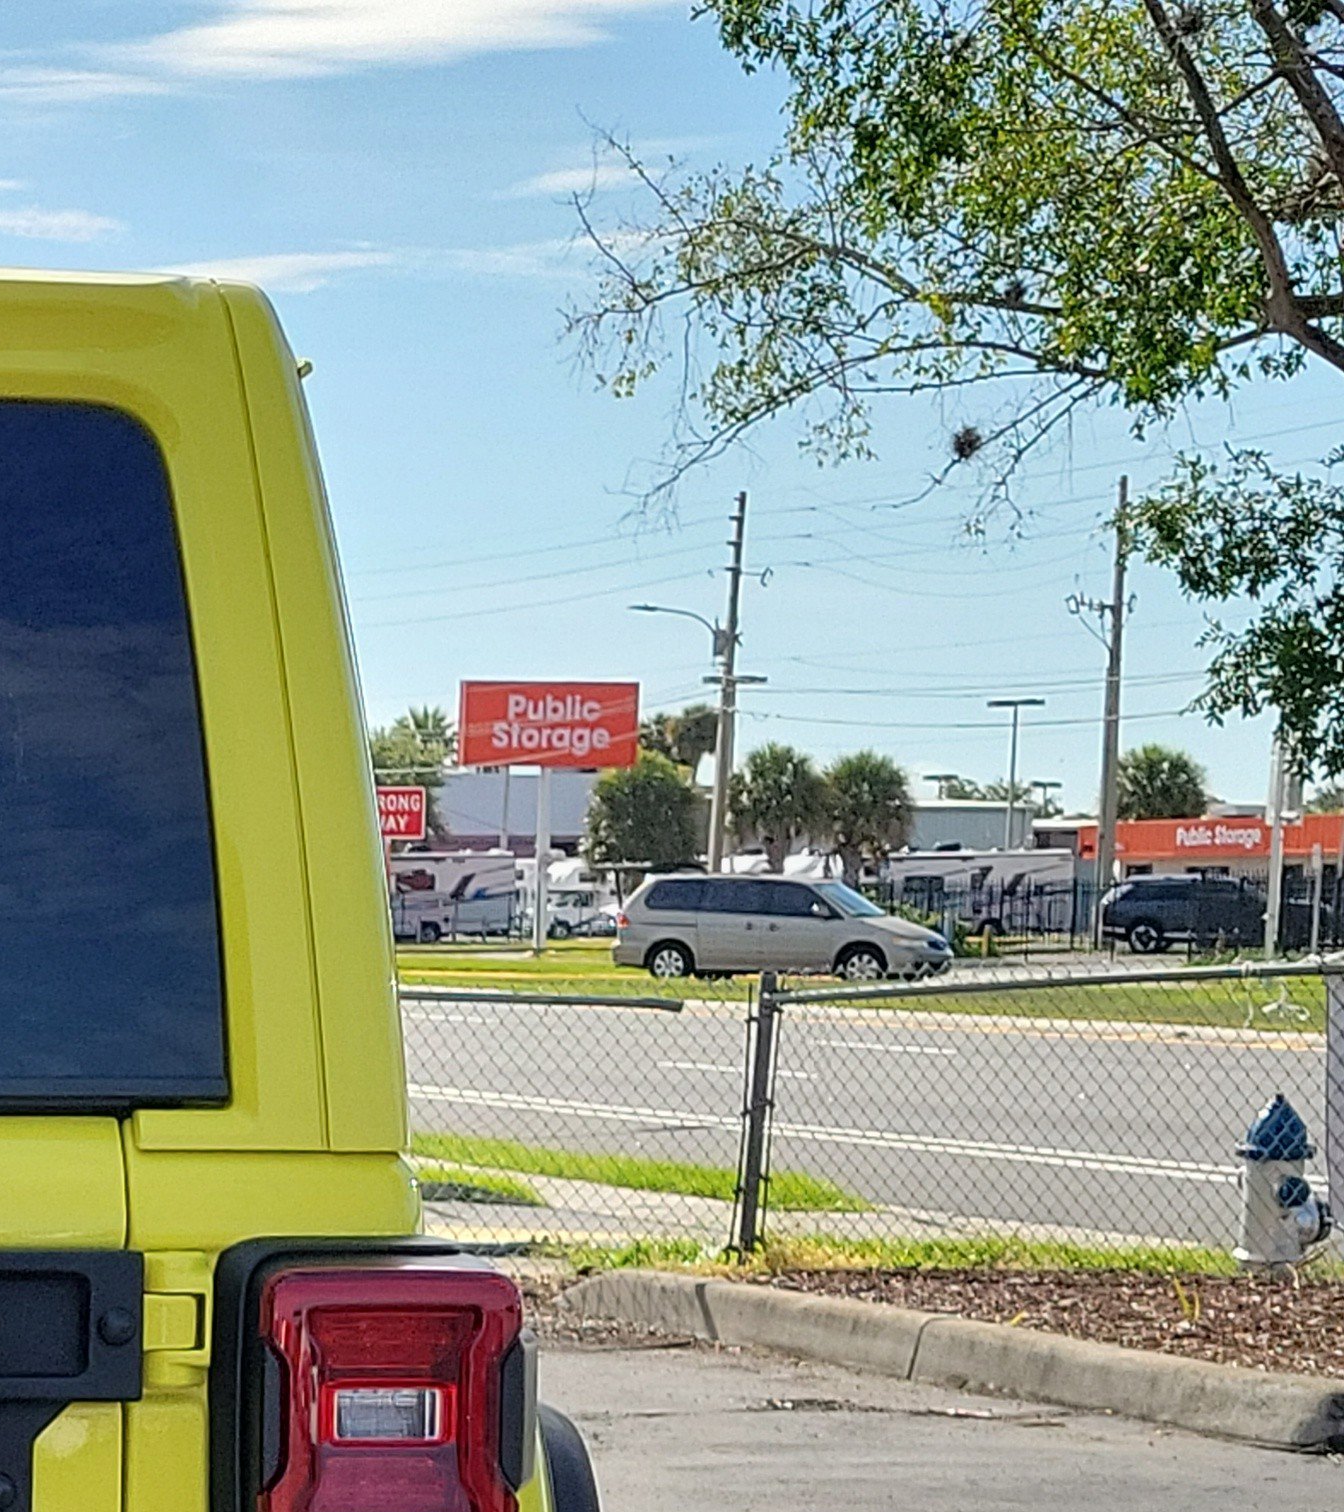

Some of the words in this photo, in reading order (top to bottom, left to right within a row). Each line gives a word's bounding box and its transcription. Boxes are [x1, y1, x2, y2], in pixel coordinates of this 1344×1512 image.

[508, 693, 602, 722] Public
[491, 721, 611, 756] Storage
[377, 794, 421, 812] RONG
[1176, 825, 1212, 847] Public
[1214, 824, 1261, 849] Storage
